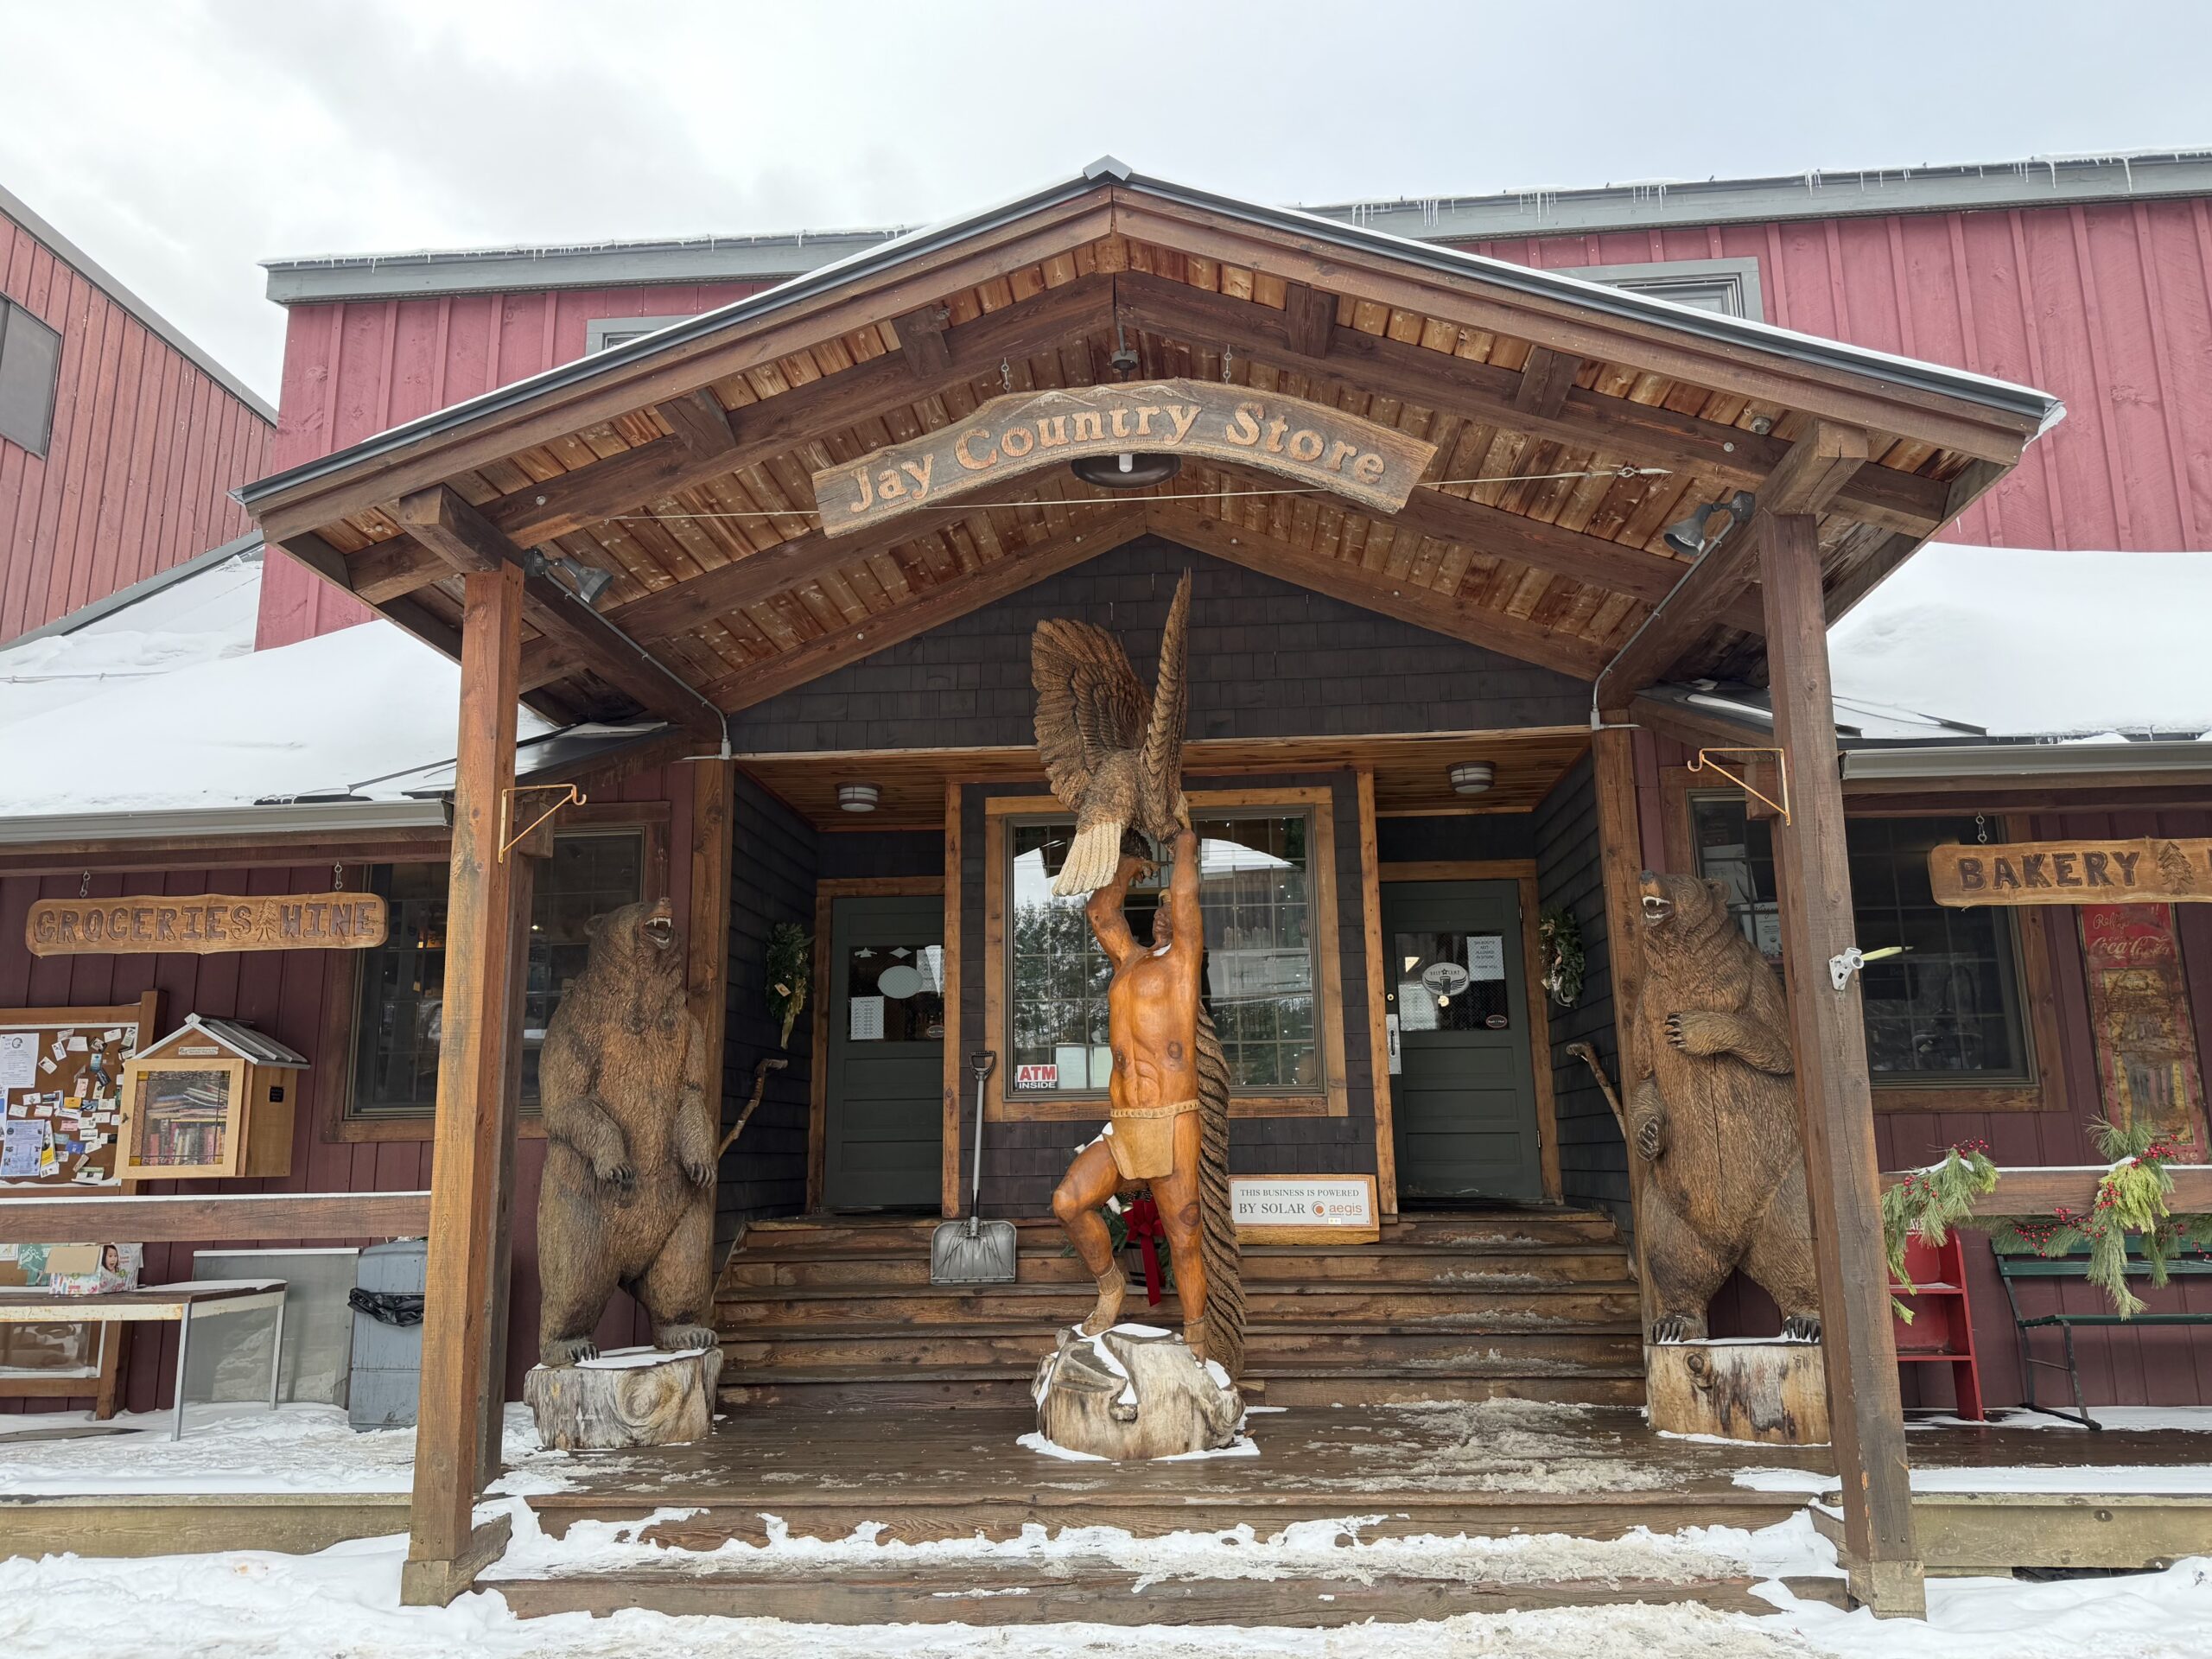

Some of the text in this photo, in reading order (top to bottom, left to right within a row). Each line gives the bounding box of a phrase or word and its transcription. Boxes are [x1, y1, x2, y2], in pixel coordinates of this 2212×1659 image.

[849, 401, 1386, 514] Jay Country Store
[1956, 850, 2140, 892] BAKERY
[33, 901, 378, 944] GROCERIES WINE
[1019, 1066, 1056, 1080] ATM
[1239, 1203, 1306, 1214] BY SOLAR
[1329, 1203, 1363, 1216] aegis
